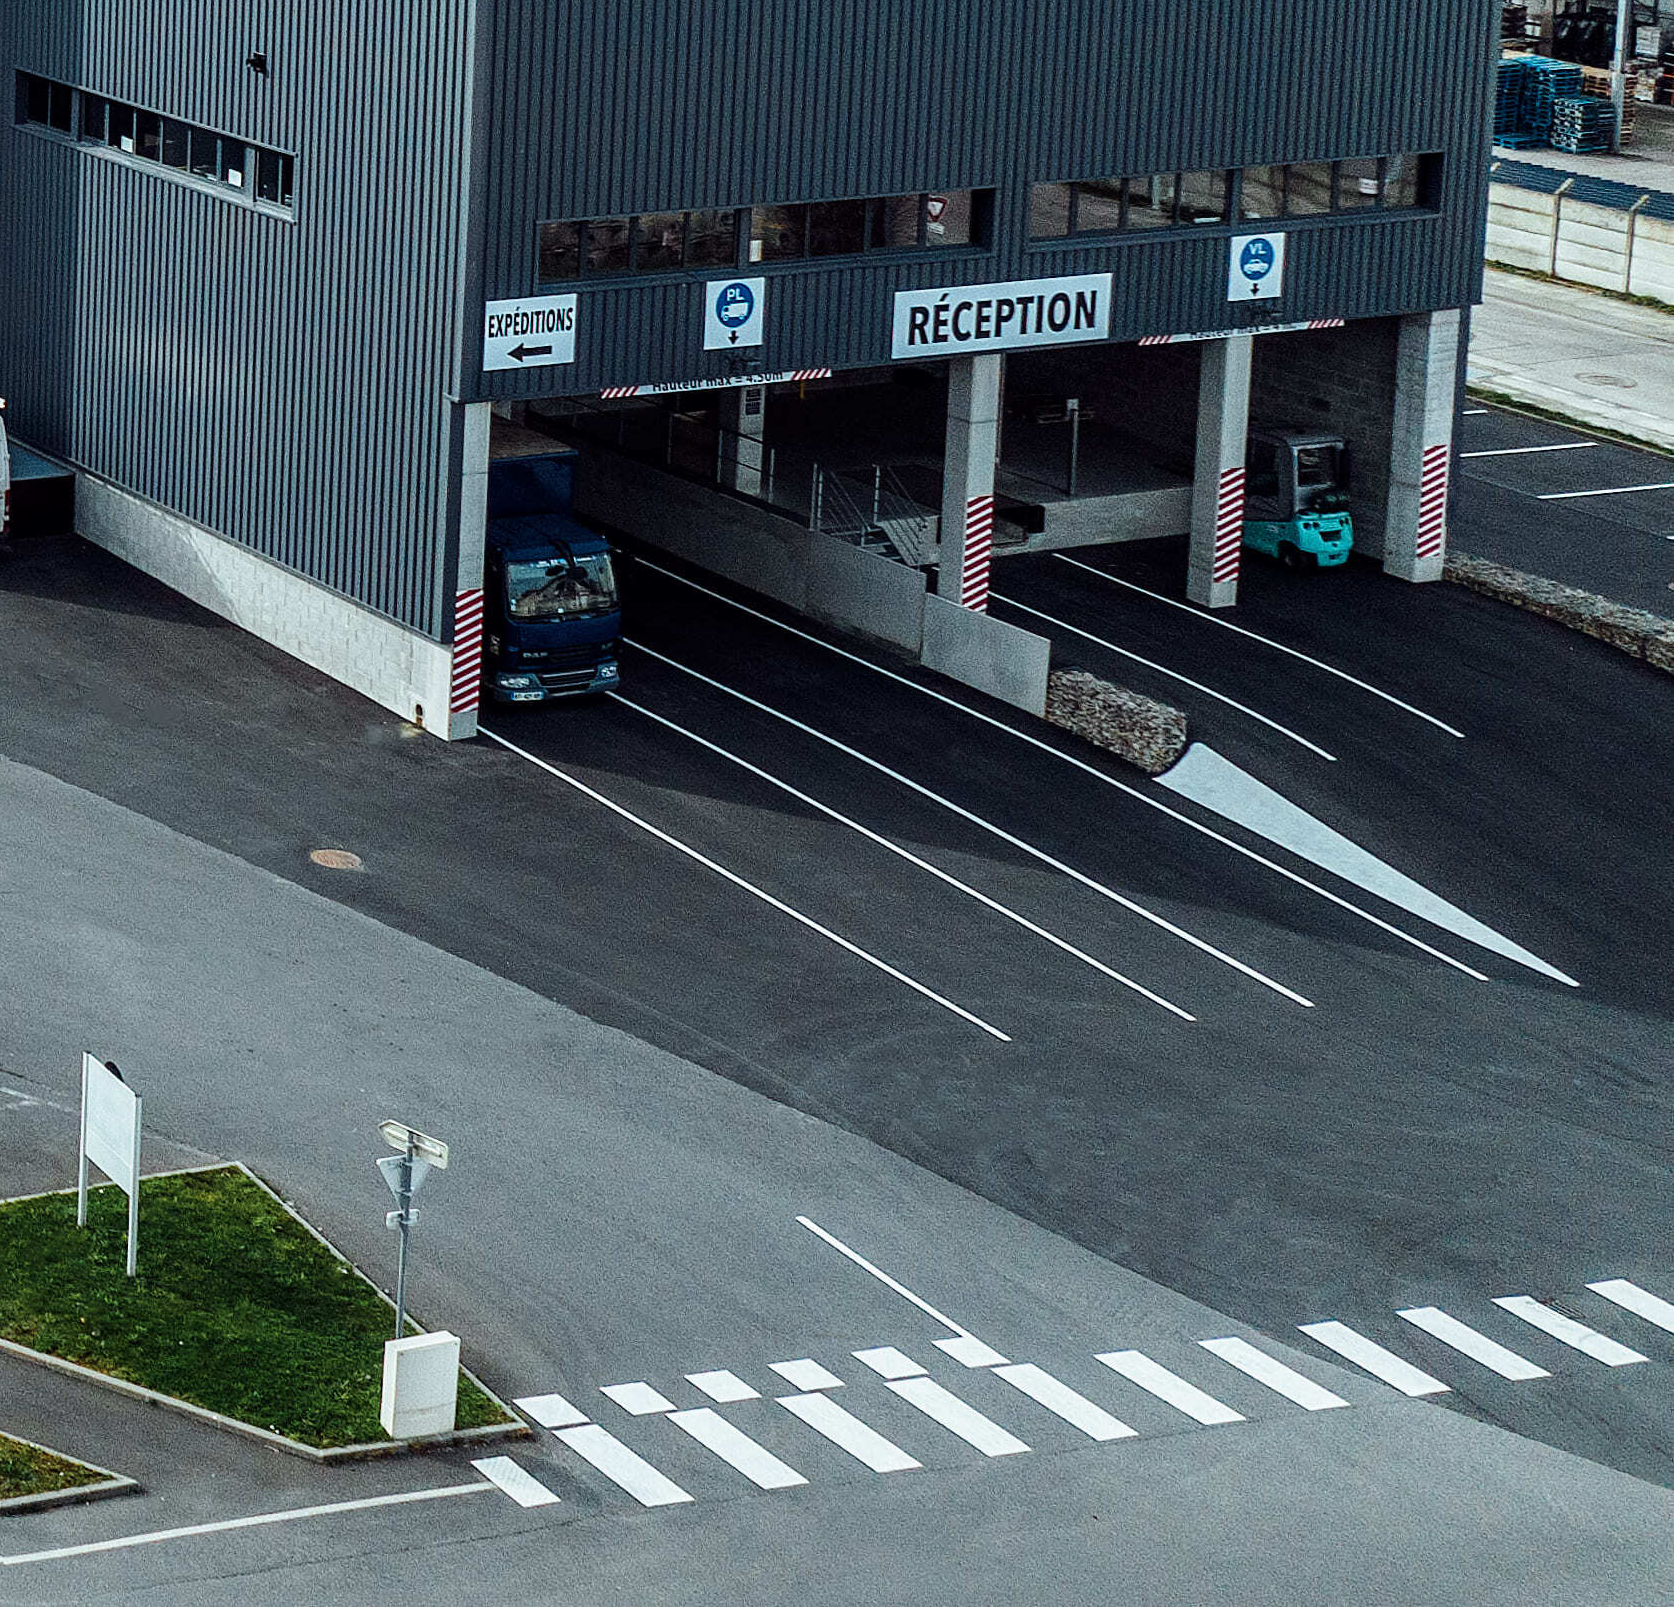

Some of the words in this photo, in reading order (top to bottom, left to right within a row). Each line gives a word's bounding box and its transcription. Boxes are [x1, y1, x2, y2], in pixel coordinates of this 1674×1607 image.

[1248, 243, 1266, 255] VL
[726, 288, 744, 301] PL
[487, 306, 573, 338] EXPÉDITIONS
[907, 288, 1098, 346] RÉCEPTION
[653, 379, 701, 393] Hauteur
[706, 377, 732, 387] max
